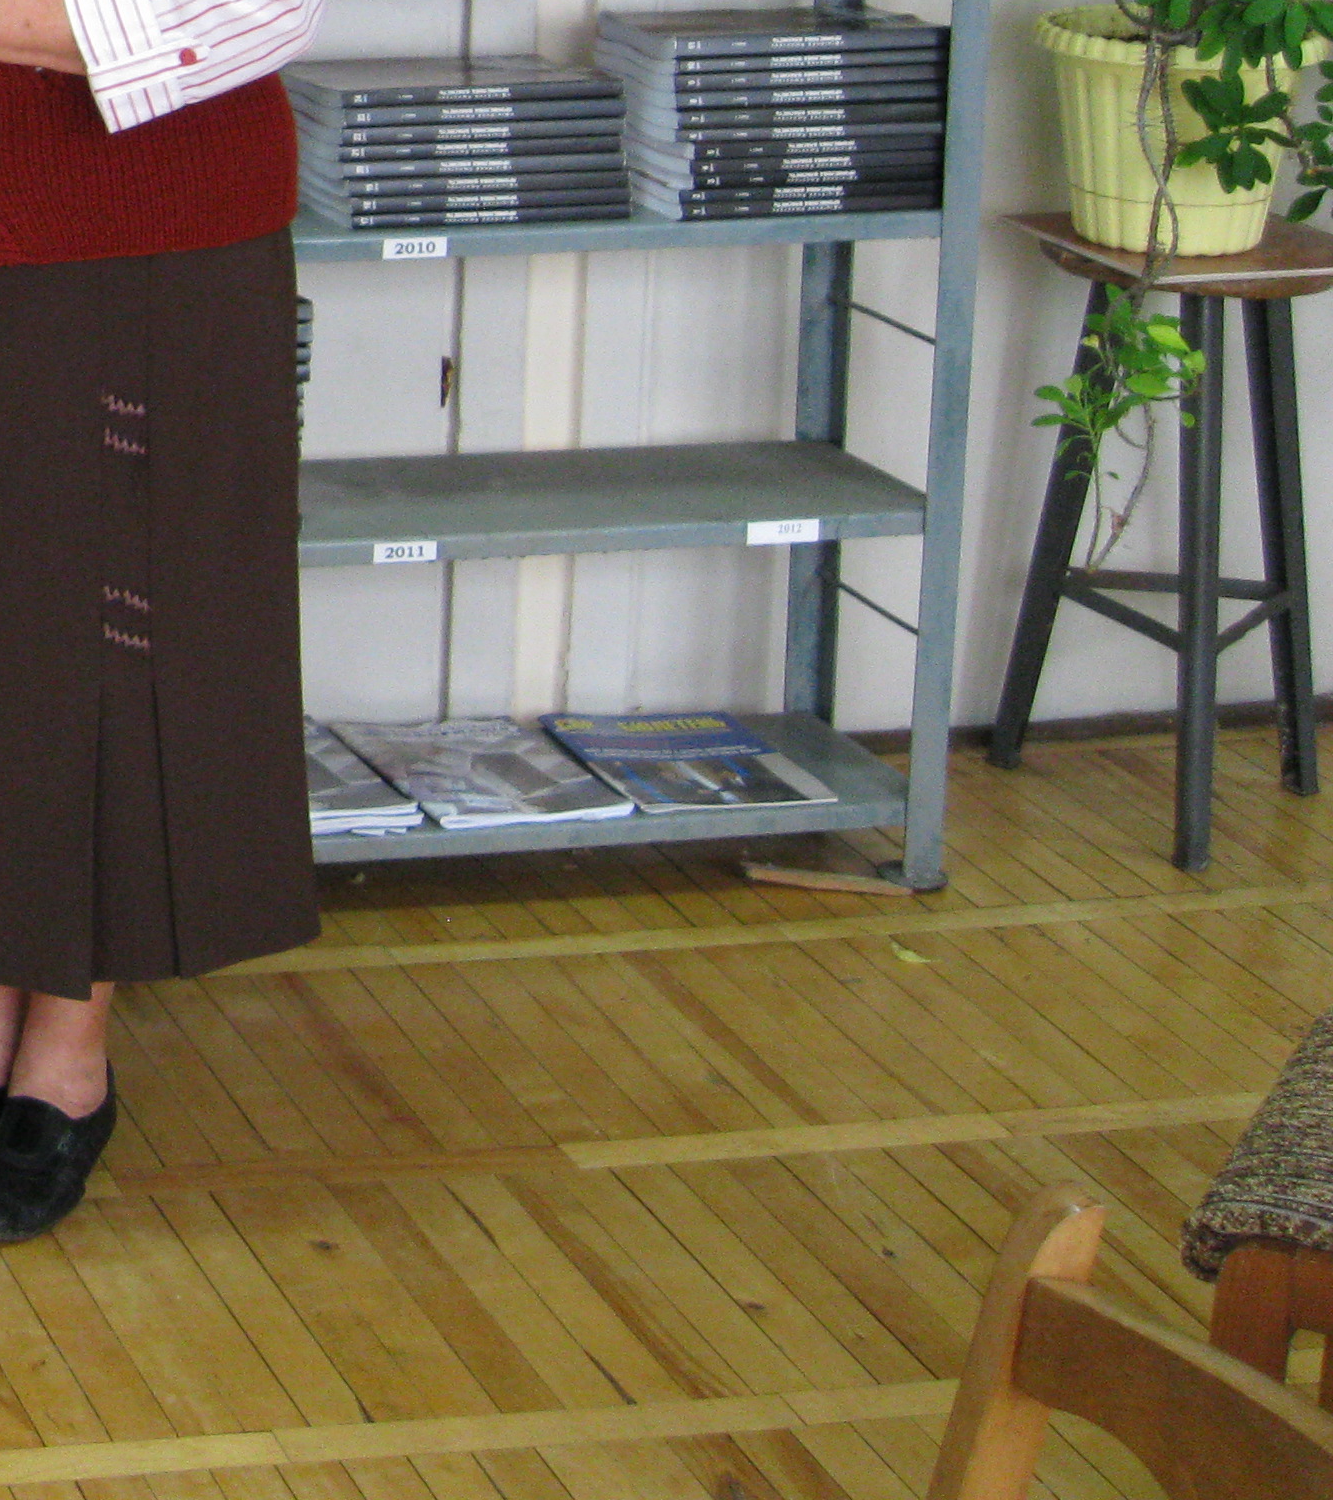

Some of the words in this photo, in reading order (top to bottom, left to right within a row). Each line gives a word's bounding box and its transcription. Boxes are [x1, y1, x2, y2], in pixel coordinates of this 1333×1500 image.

[393, 241, 437, 256] 2010
[777, 522, 803, 534] 2012
[383, 545, 426, 560] 2011
